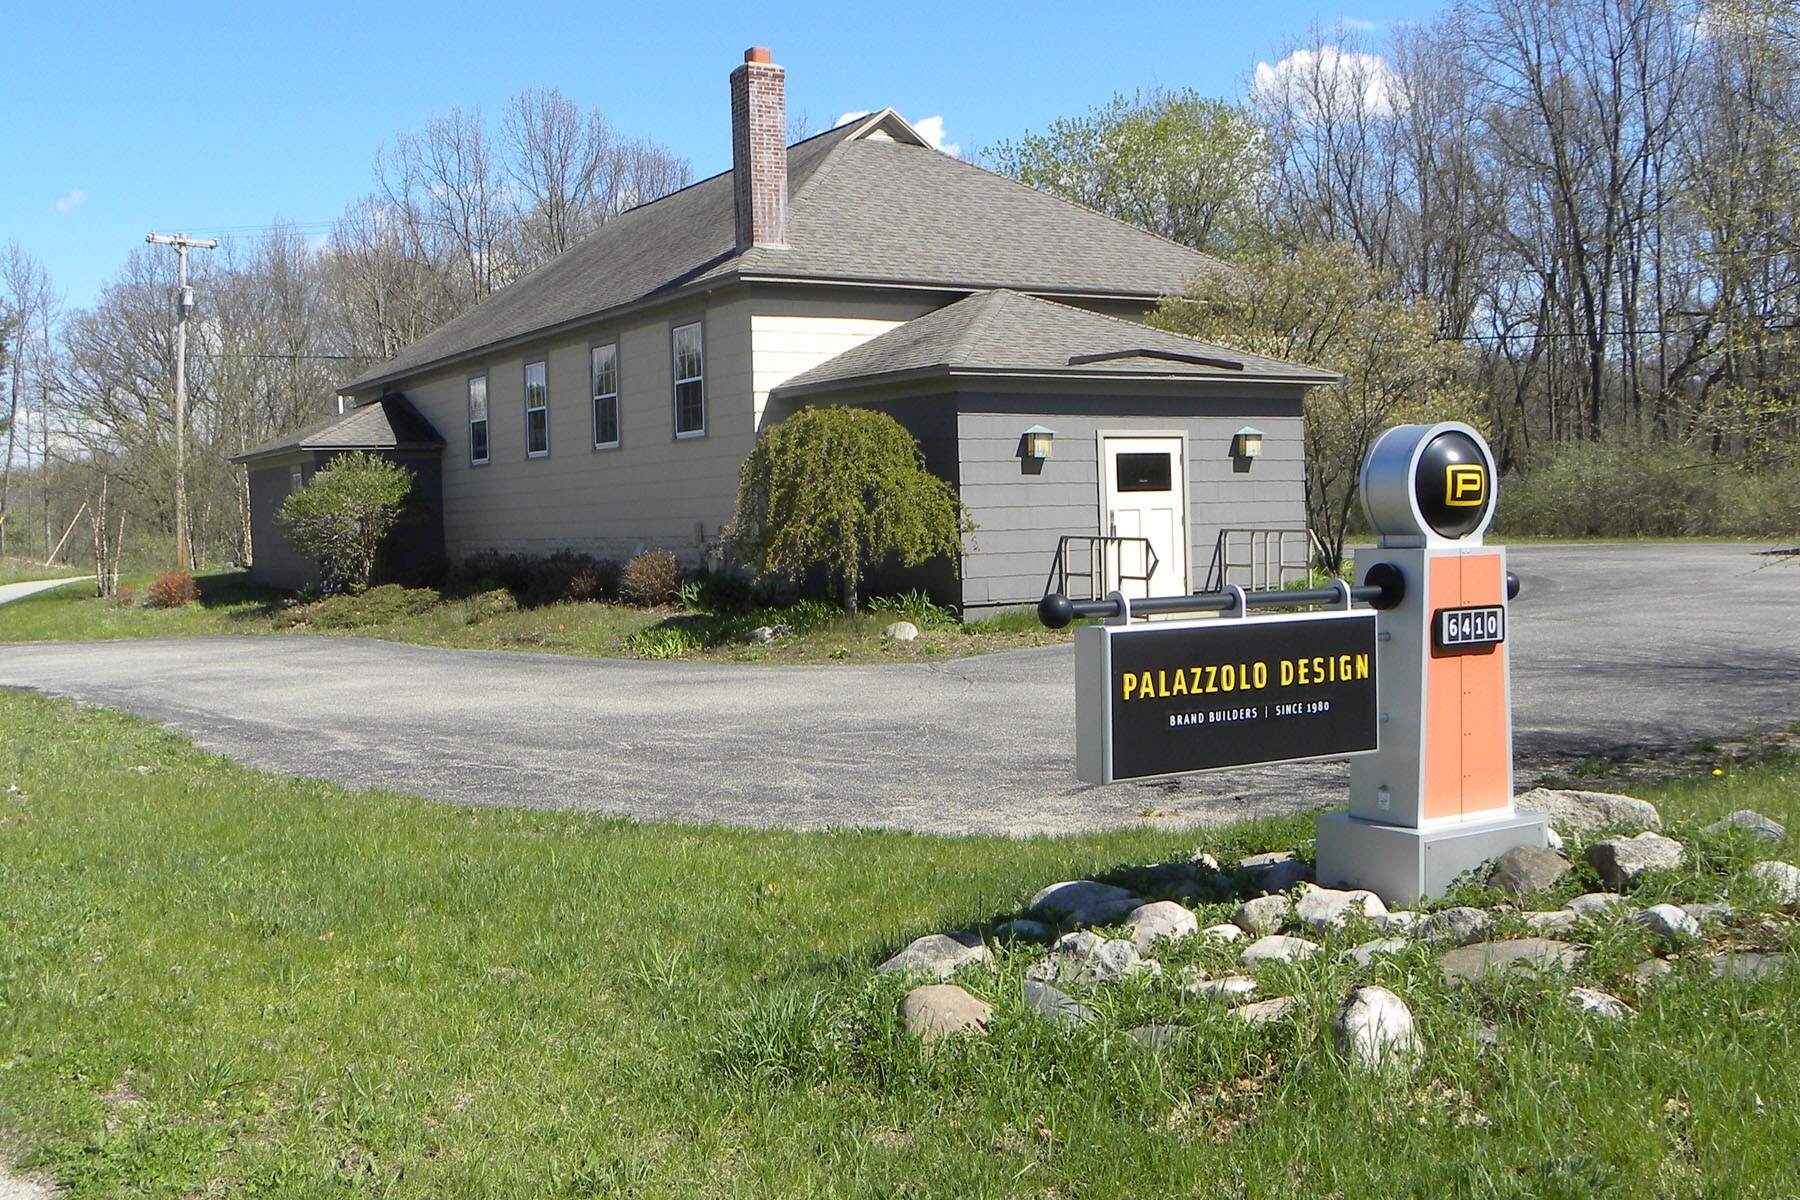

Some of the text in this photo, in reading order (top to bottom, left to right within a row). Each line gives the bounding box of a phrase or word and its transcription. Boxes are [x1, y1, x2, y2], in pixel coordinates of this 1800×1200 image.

[1449, 616, 1497, 637] 6410
[1122, 653, 1370, 700] PALAZZOLO DESIGN
[1169, 701, 1330, 727] BRAND BUILDERS SINCE 1980
